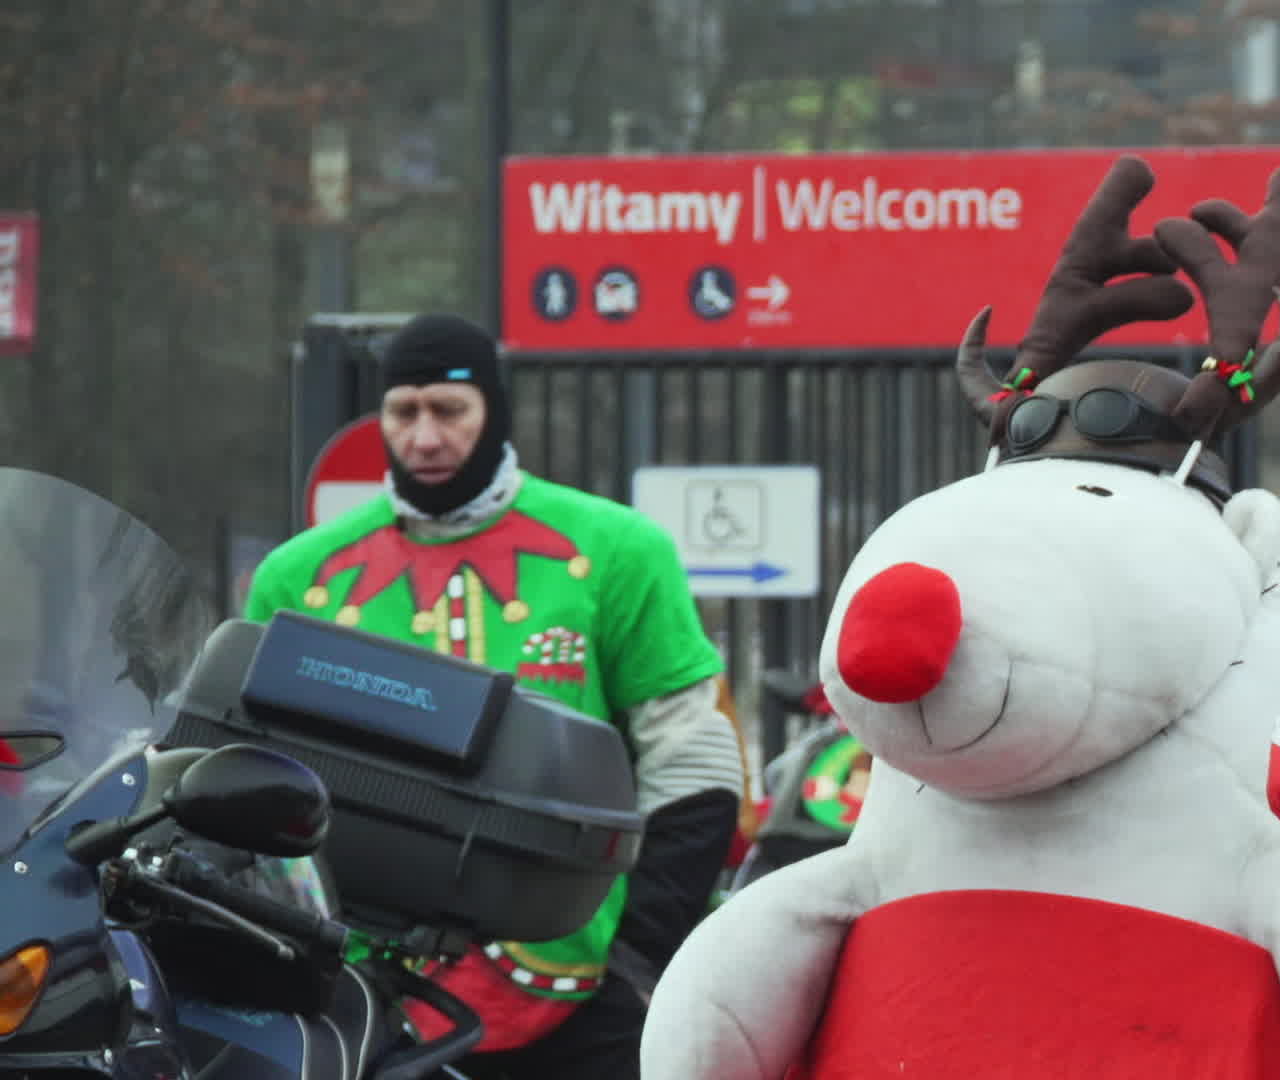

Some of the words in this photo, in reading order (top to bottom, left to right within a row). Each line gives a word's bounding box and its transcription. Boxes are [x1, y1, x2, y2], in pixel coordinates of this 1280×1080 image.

[529, 181, 742, 245] Witamy
[776, 176, 1022, 231] Welcome
[296, 655, 439, 712] HONDA
